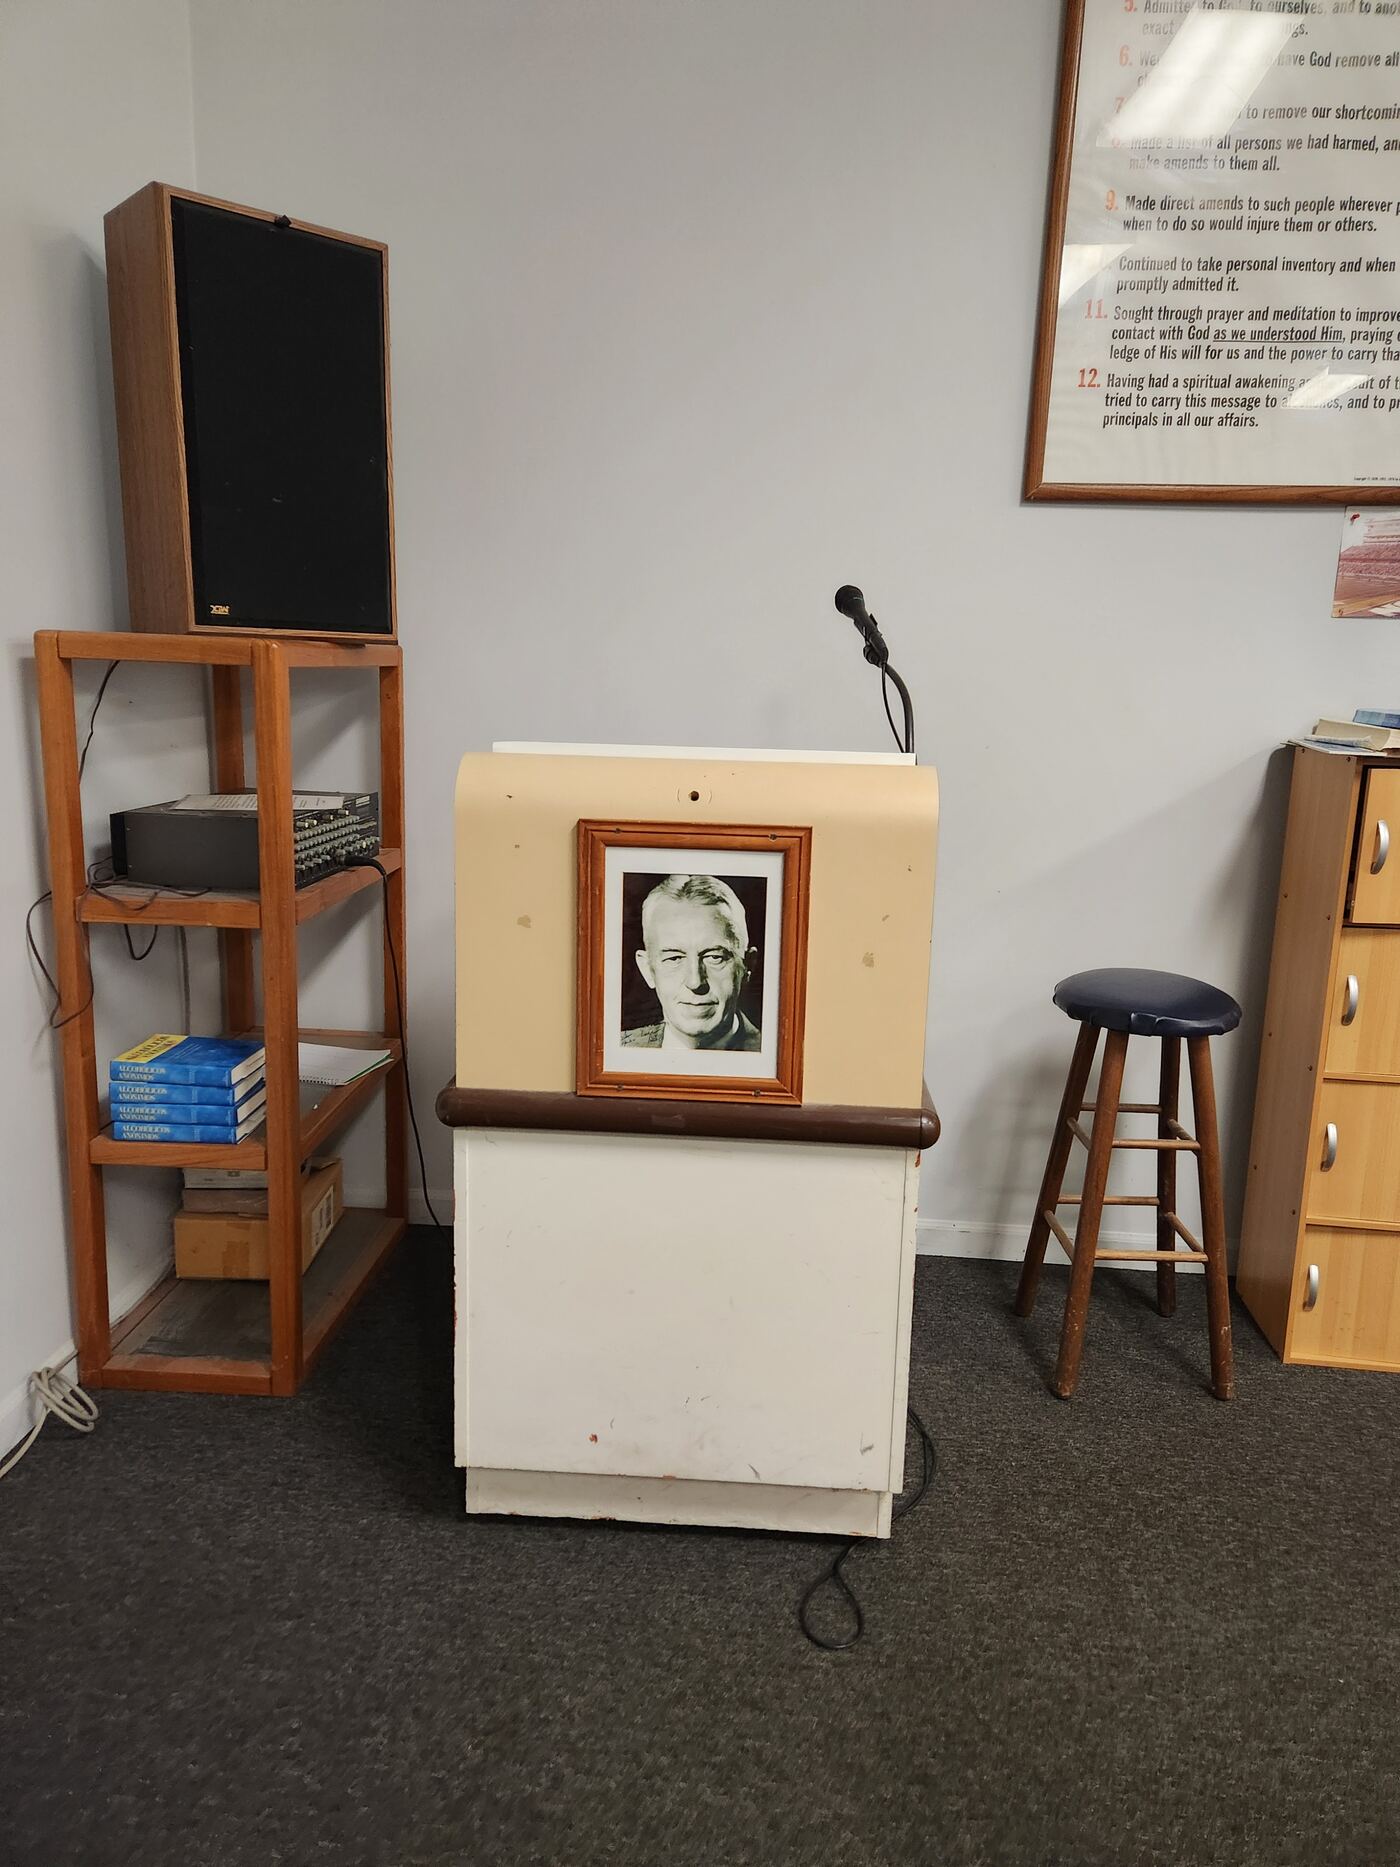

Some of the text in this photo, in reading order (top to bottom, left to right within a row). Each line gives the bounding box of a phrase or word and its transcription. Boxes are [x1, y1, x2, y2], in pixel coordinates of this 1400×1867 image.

[1144, 0, 1192, 14] Admitte
[1360, 0, 1371, 14] to
[1142, 21, 1175, 35] exact
[1119, 45, 1133, 66] 6.
[1309, 51, 1331, 67] God
[1335, 54, 1381, 68] remove
[1246, 104, 1258, 119] to
[1262, 106, 1307, 119] remove
[1312, 106, 1332, 119] our
[1217, 135, 1231, 149] all
[1235, 138, 1282, 153] persons
[1287, 139, 1302, 150] we
[1307, 134, 1330, 149] had
[1333, 134, 1379, 153] harmed,
[1129, 154, 1280, 171] make amends to them all.
[1104, 189, 1118, 211] 9.
[1125, 195, 1156, 211] Made
[1160, 195, 1195, 211] direct
[1199, 195, 1244, 211] amends
[1248, 196, 1260, 211] to
[1263, 197, 1291, 212] such
[1294, 196, 1335, 215] people
[1340, 196, 1393, 212] wherever
[1123, 216, 1378, 234] when to do so would injure them or others.
[1119, 256, 1177, 271] Continued
[1181, 257, 1193, 271] to
[1197, 256, 1222, 271] take
[1226, 256, 1278, 274] personal
[1281, 257, 1336, 276] inventory
[1339, 257, 1362, 272] and
[1366, 257, 1396, 272] when
[1116, 276, 1240, 294] promptly admitted it.
[1084, 299, 1400, 325] 11. Sought through prayer and meditation to improve
[1111, 325, 1155, 340] contact
[1160, 326, 1183, 340] with
[1188, 325, 1210, 340] God
[1213, 329, 1227, 341] as
[1231, 329, 1246, 341] we
[1250, 326, 1318, 342] understood
[1320, 326, 1346, 343] Him,
[1350, 327, 1394, 345] praying
[1109, 345, 1140, 362] ledge
[1144, 345, 1156, 360] of
[1160, 345, 1177, 360] His
[1181, 345, 1201, 360] will
[1205, 345, 1223, 360] for
[1226, 349, 1240, 360] us
[1244, 346, 1265, 360] and
[1268, 346, 1287, 360] the
[1290, 349, 1328, 364] power
[1331, 347, 1343, 361] to
[1347, 349, 1379, 364] carry
[1077, 368, 1101, 388] 12.
[1106, 373, 1145, 391] Having
[1148, 374, 1169, 389] had
[1172, 378, 1179, 388] a
[1182, 374, 1232, 391] spiritual
[1235, 374, 1296, 392] awakening
[1378, 376, 1391, 390] of
[1105, 393, 1132, 407] tried
[1136, 393, 1147, 407] to
[1151, 396, 1181, 410] carry
[1185, 394, 1207, 408] this
[1210, 396, 1261, 412] message
[1265, 394, 1277, 409] to
[1347, 395, 1370, 409] and
[1373, 395, 1385, 409] to
[1102, 411, 1259, 430] principals in all our affairs.
